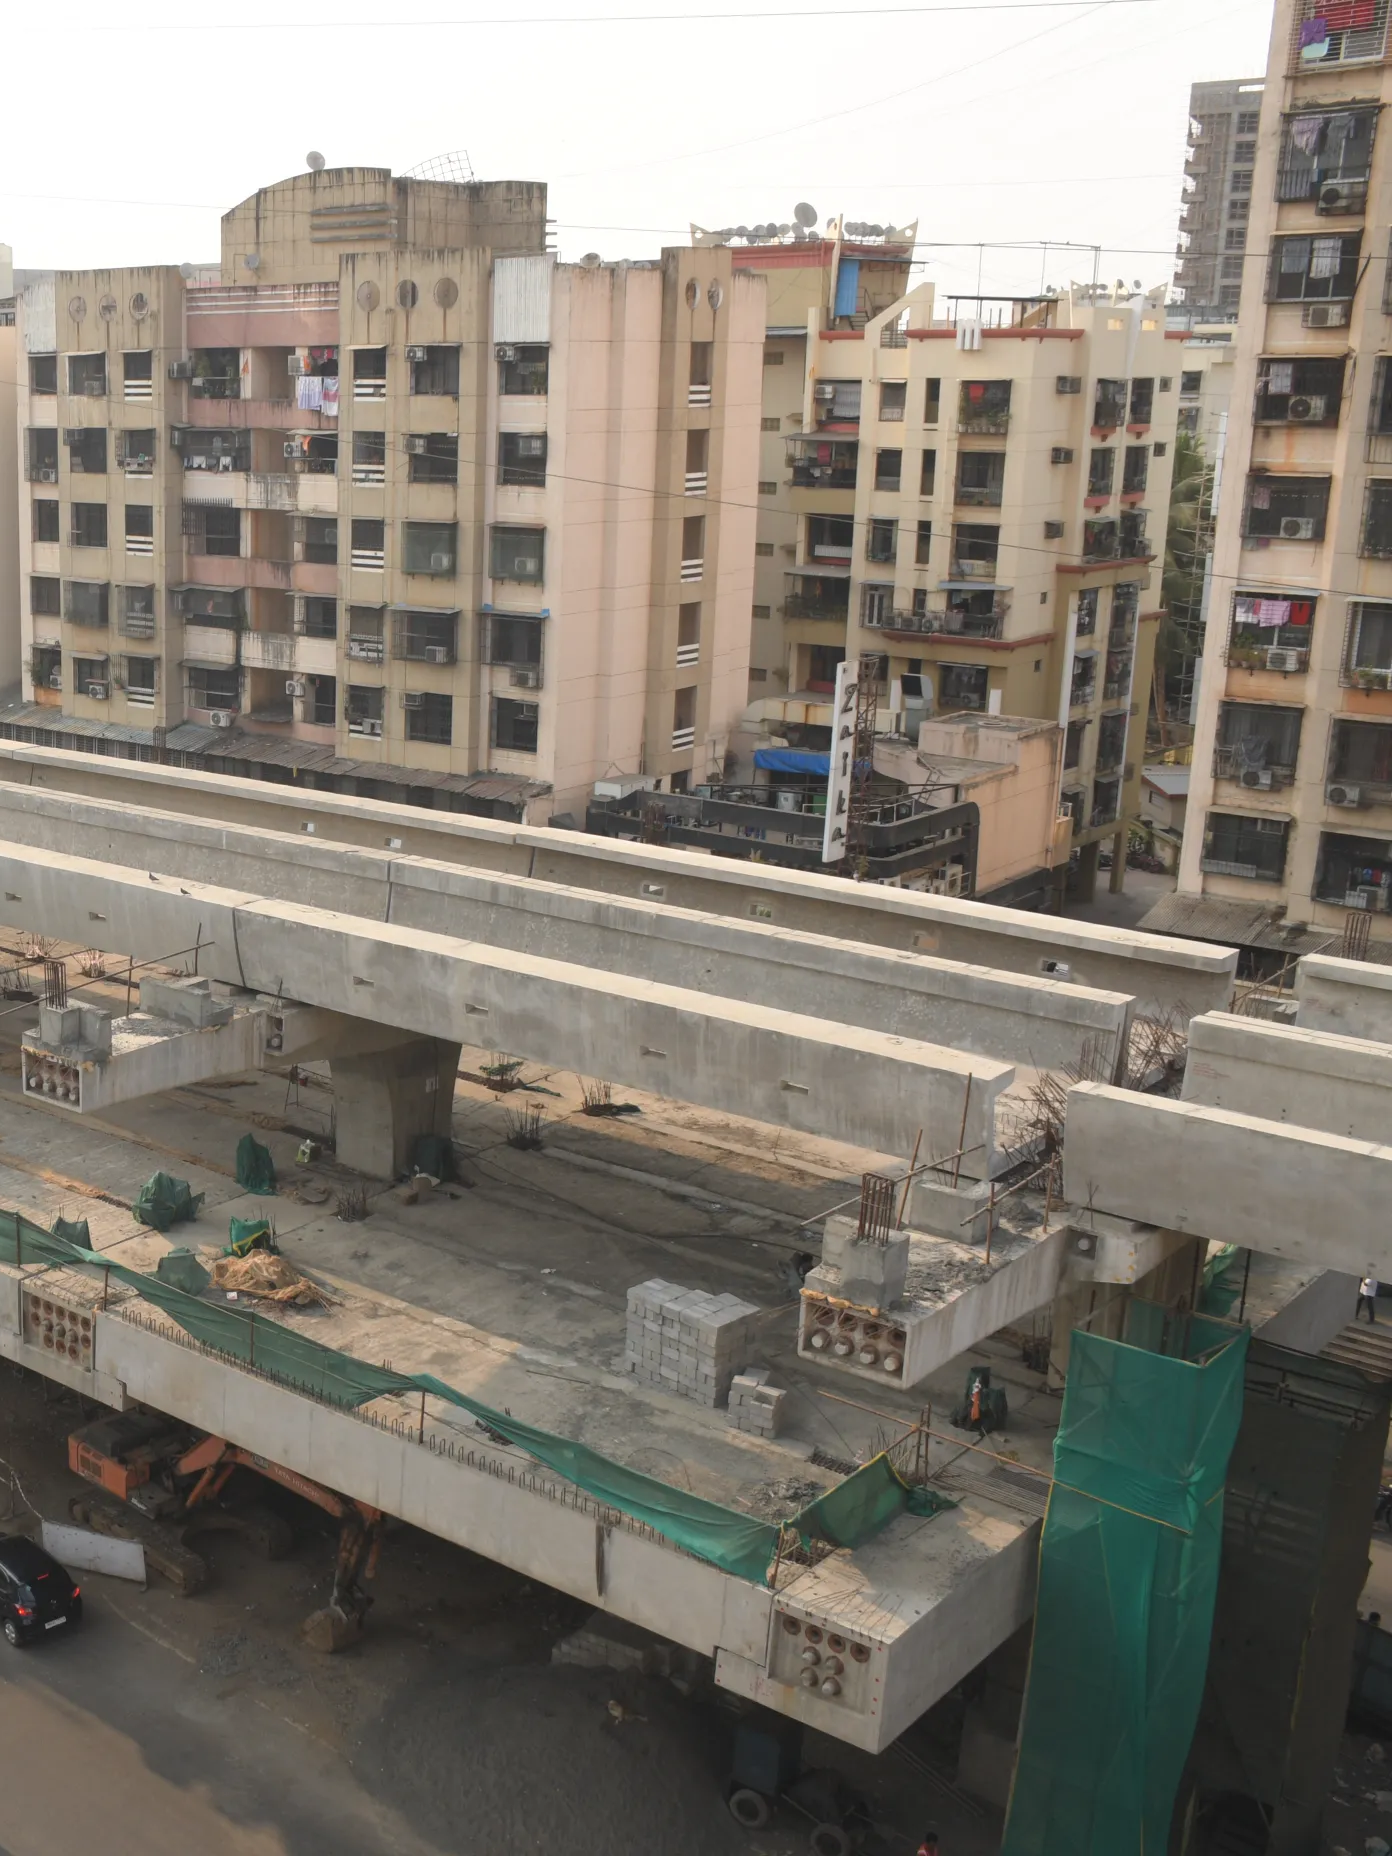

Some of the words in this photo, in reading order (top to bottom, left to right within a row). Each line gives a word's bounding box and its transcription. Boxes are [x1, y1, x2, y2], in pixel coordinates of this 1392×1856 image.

[831, 682, 858, 843] Zaika
[274, 1466, 291, 1480] TATA
[292, 1477, 320, 1498] HITACHI
